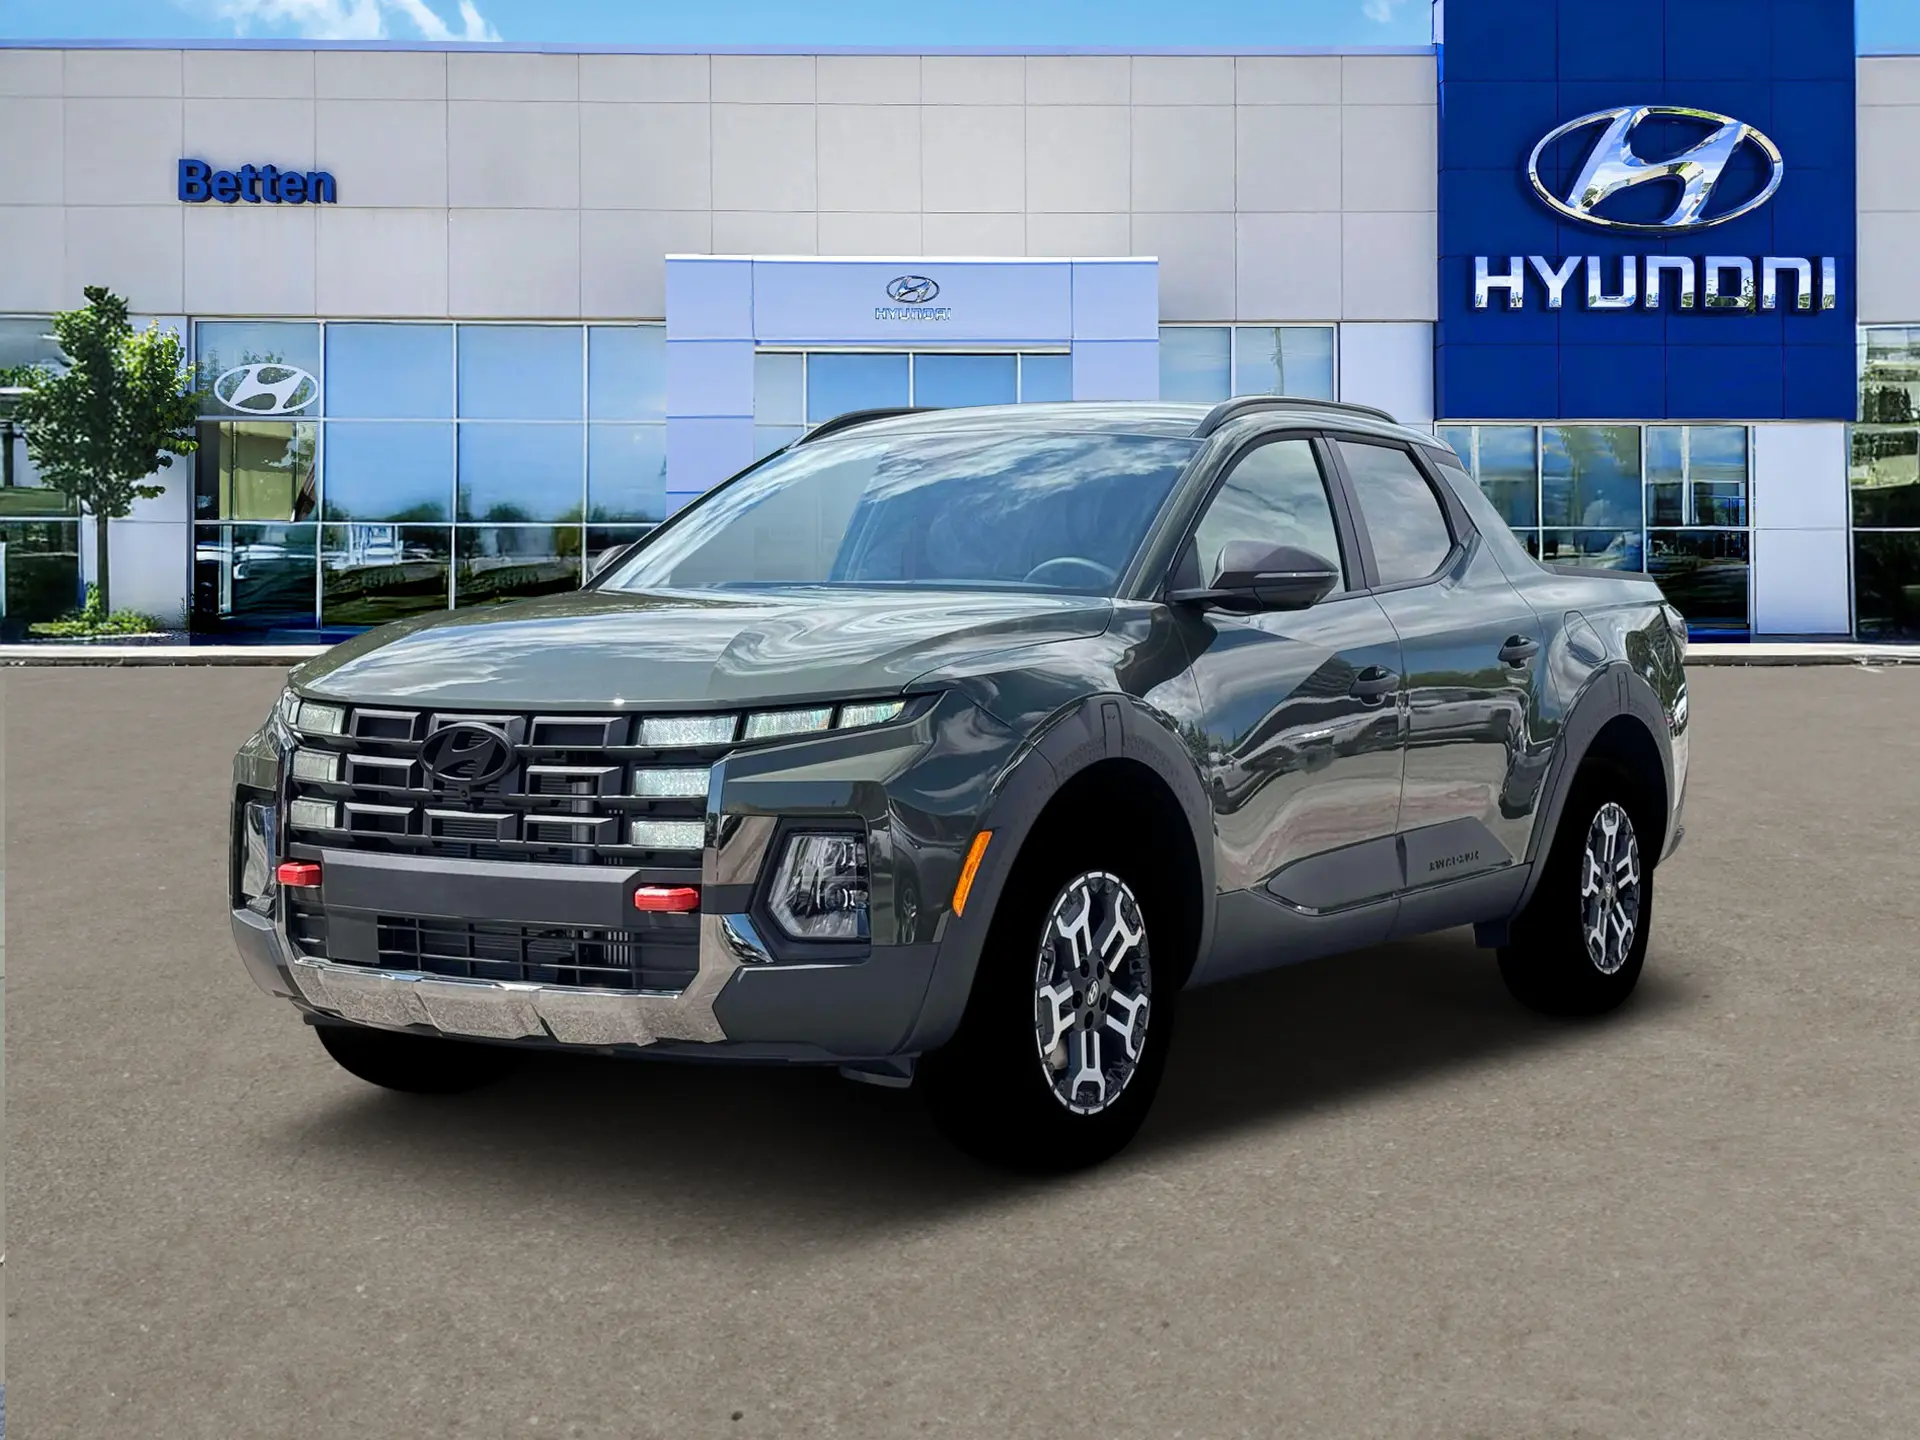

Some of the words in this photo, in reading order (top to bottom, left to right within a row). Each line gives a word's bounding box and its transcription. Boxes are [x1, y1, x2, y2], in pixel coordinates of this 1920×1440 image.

[178, 158, 337, 204] Betten
[1473, 254, 1837, 311] HYUNDAI
[874, 307, 952, 321] HYUNDAI
